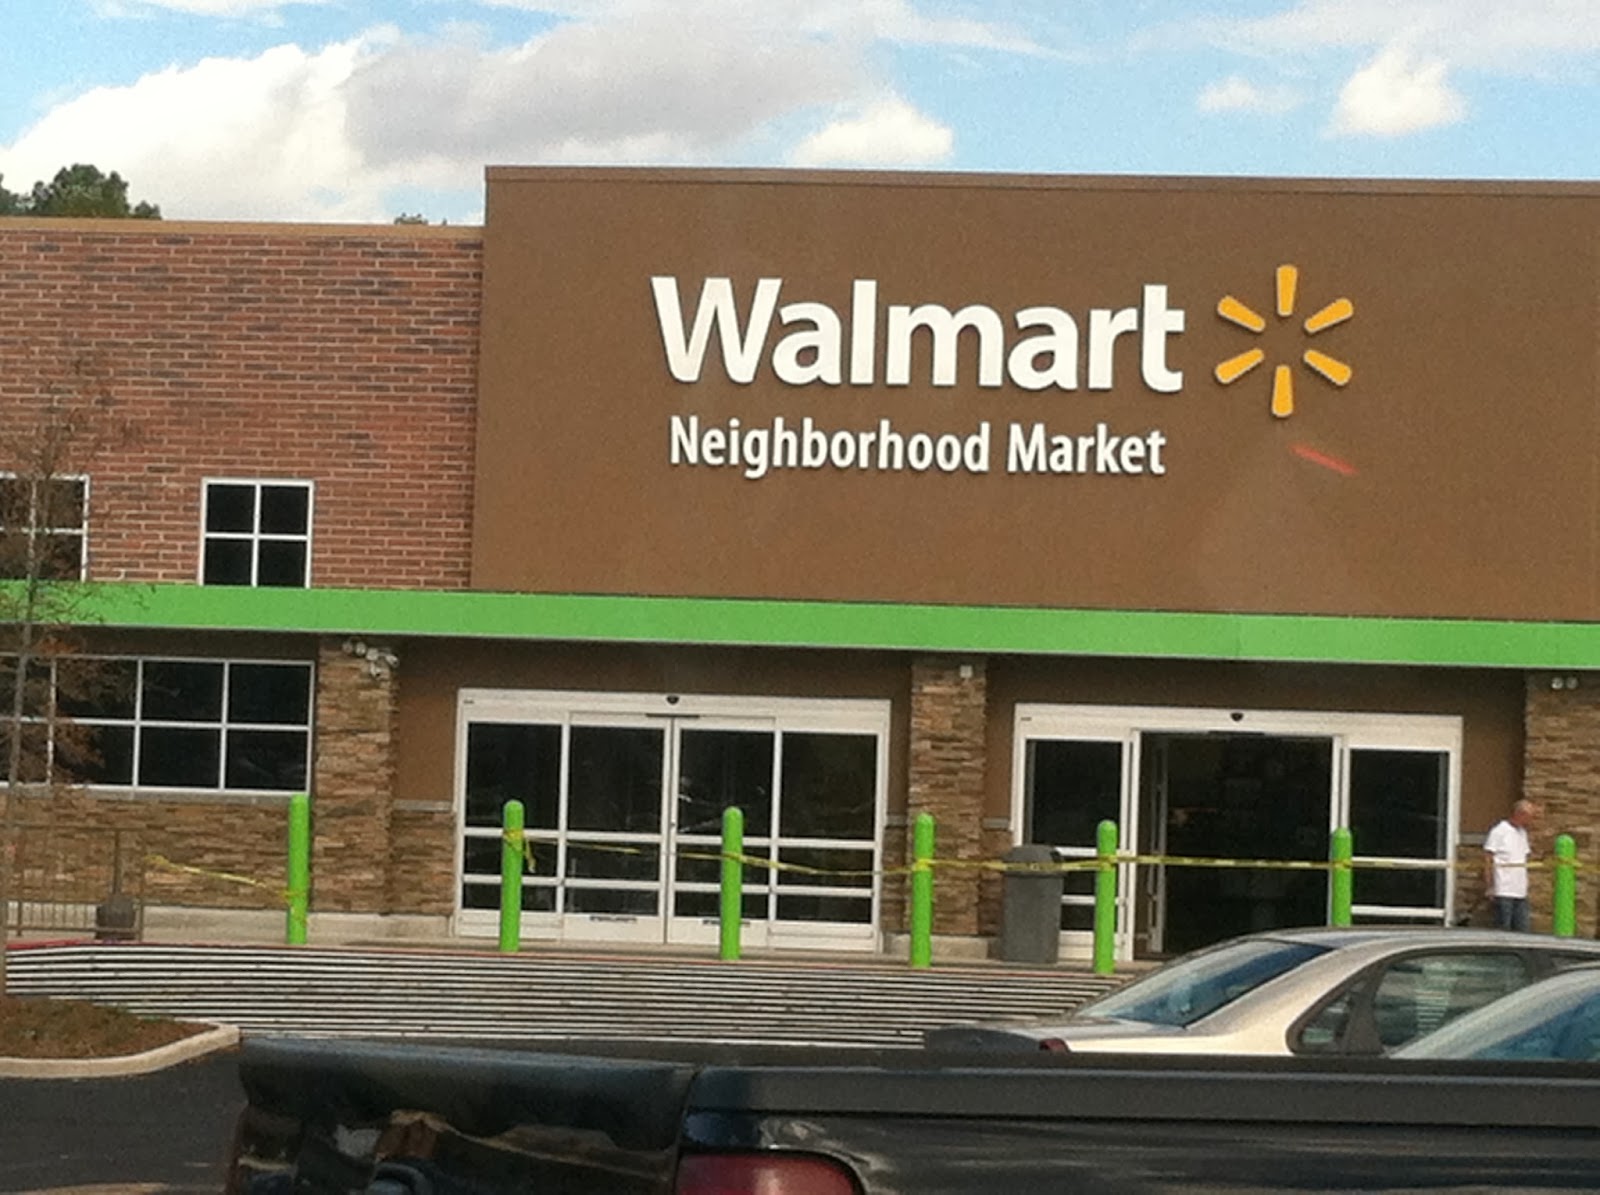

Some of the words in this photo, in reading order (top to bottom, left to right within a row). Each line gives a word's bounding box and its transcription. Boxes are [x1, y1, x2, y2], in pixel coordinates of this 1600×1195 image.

[651, 276, 1185, 393] Walmart
[669, 415, 991, 479] Neighborhood
[1007, 423, 1167, 476] Market
